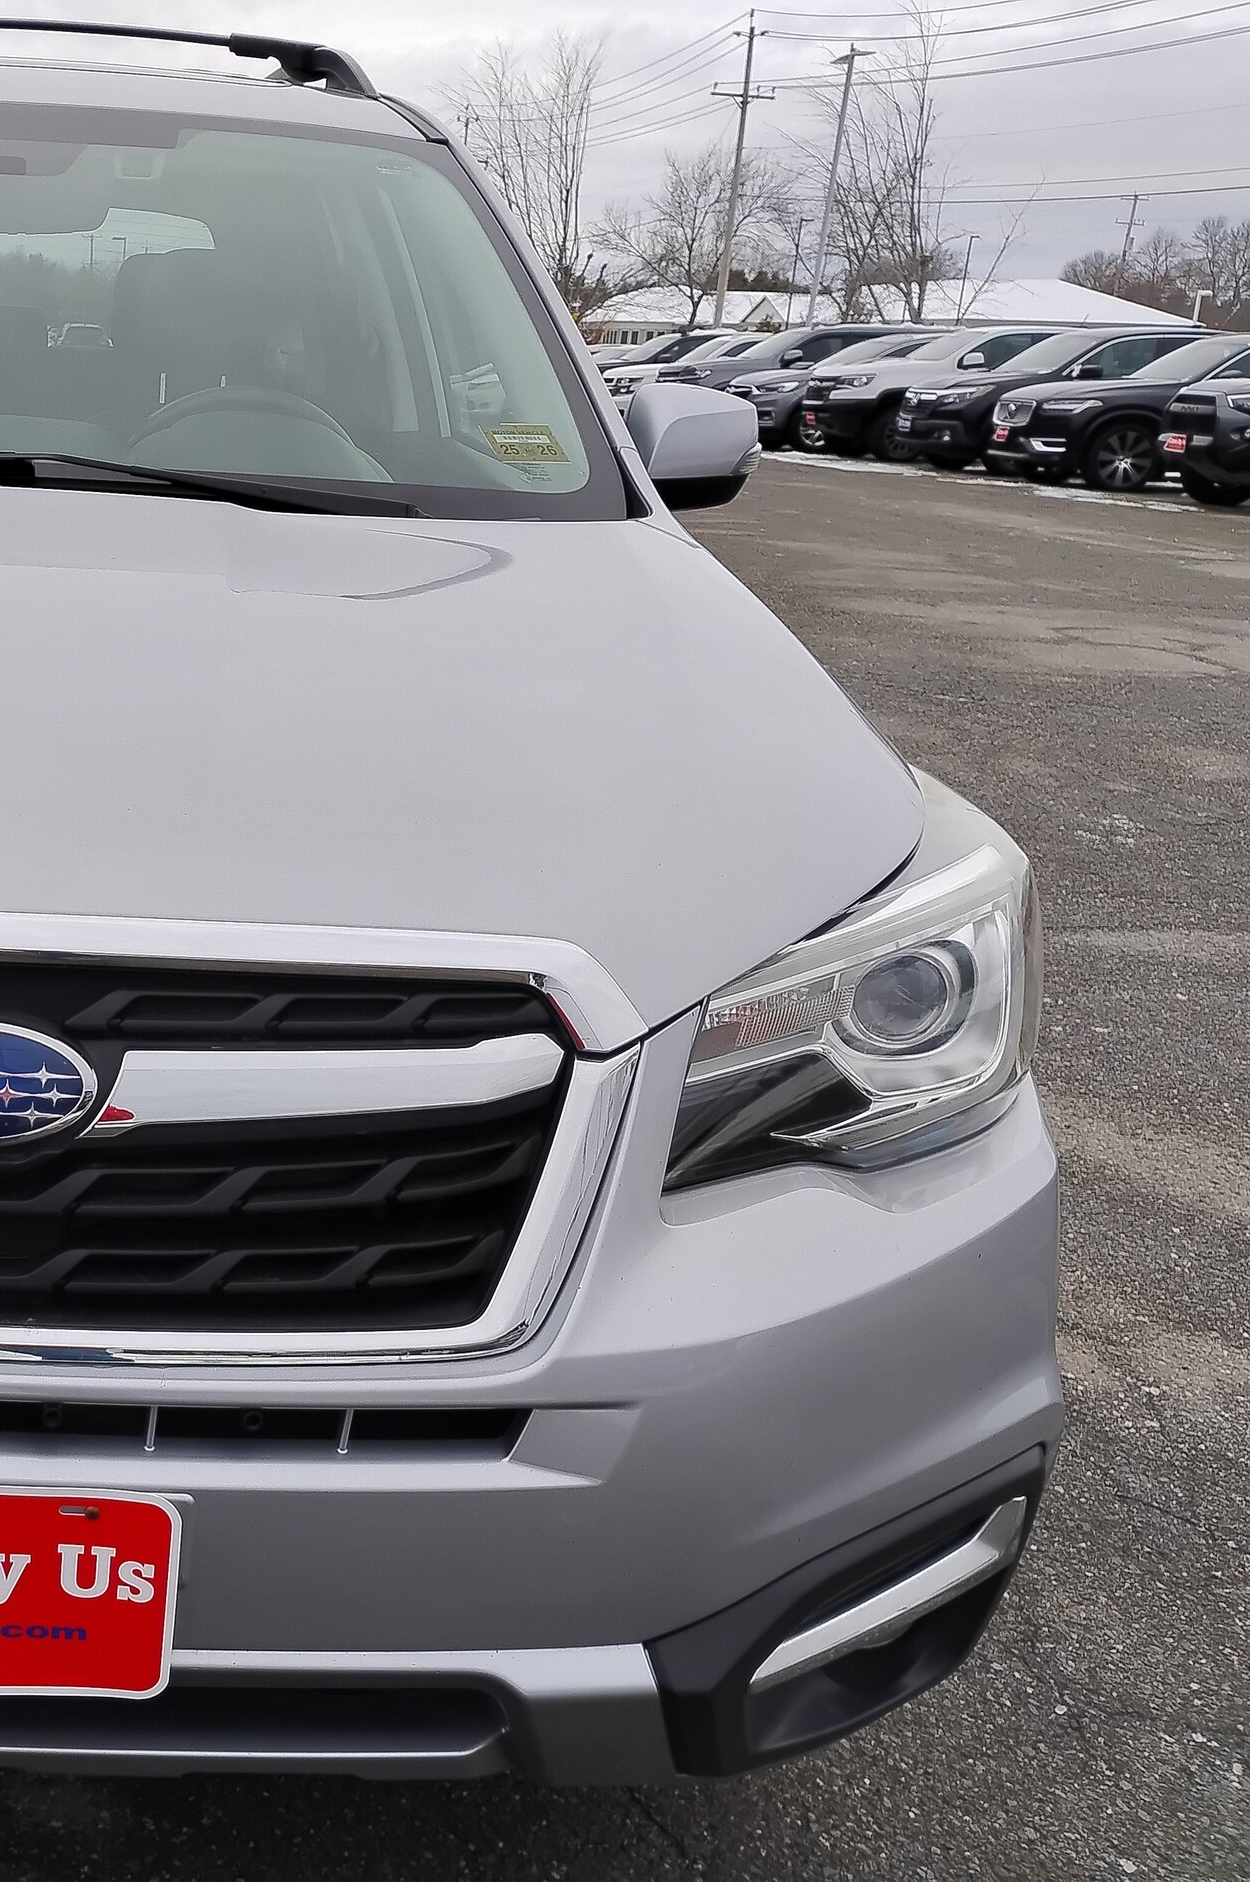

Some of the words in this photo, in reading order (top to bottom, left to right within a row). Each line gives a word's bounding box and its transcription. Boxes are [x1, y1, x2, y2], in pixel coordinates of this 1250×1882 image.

[499, 444, 520, 455] 25
[536, 444, 558, 456] 26
[57, 1543, 155, 1604] Us
